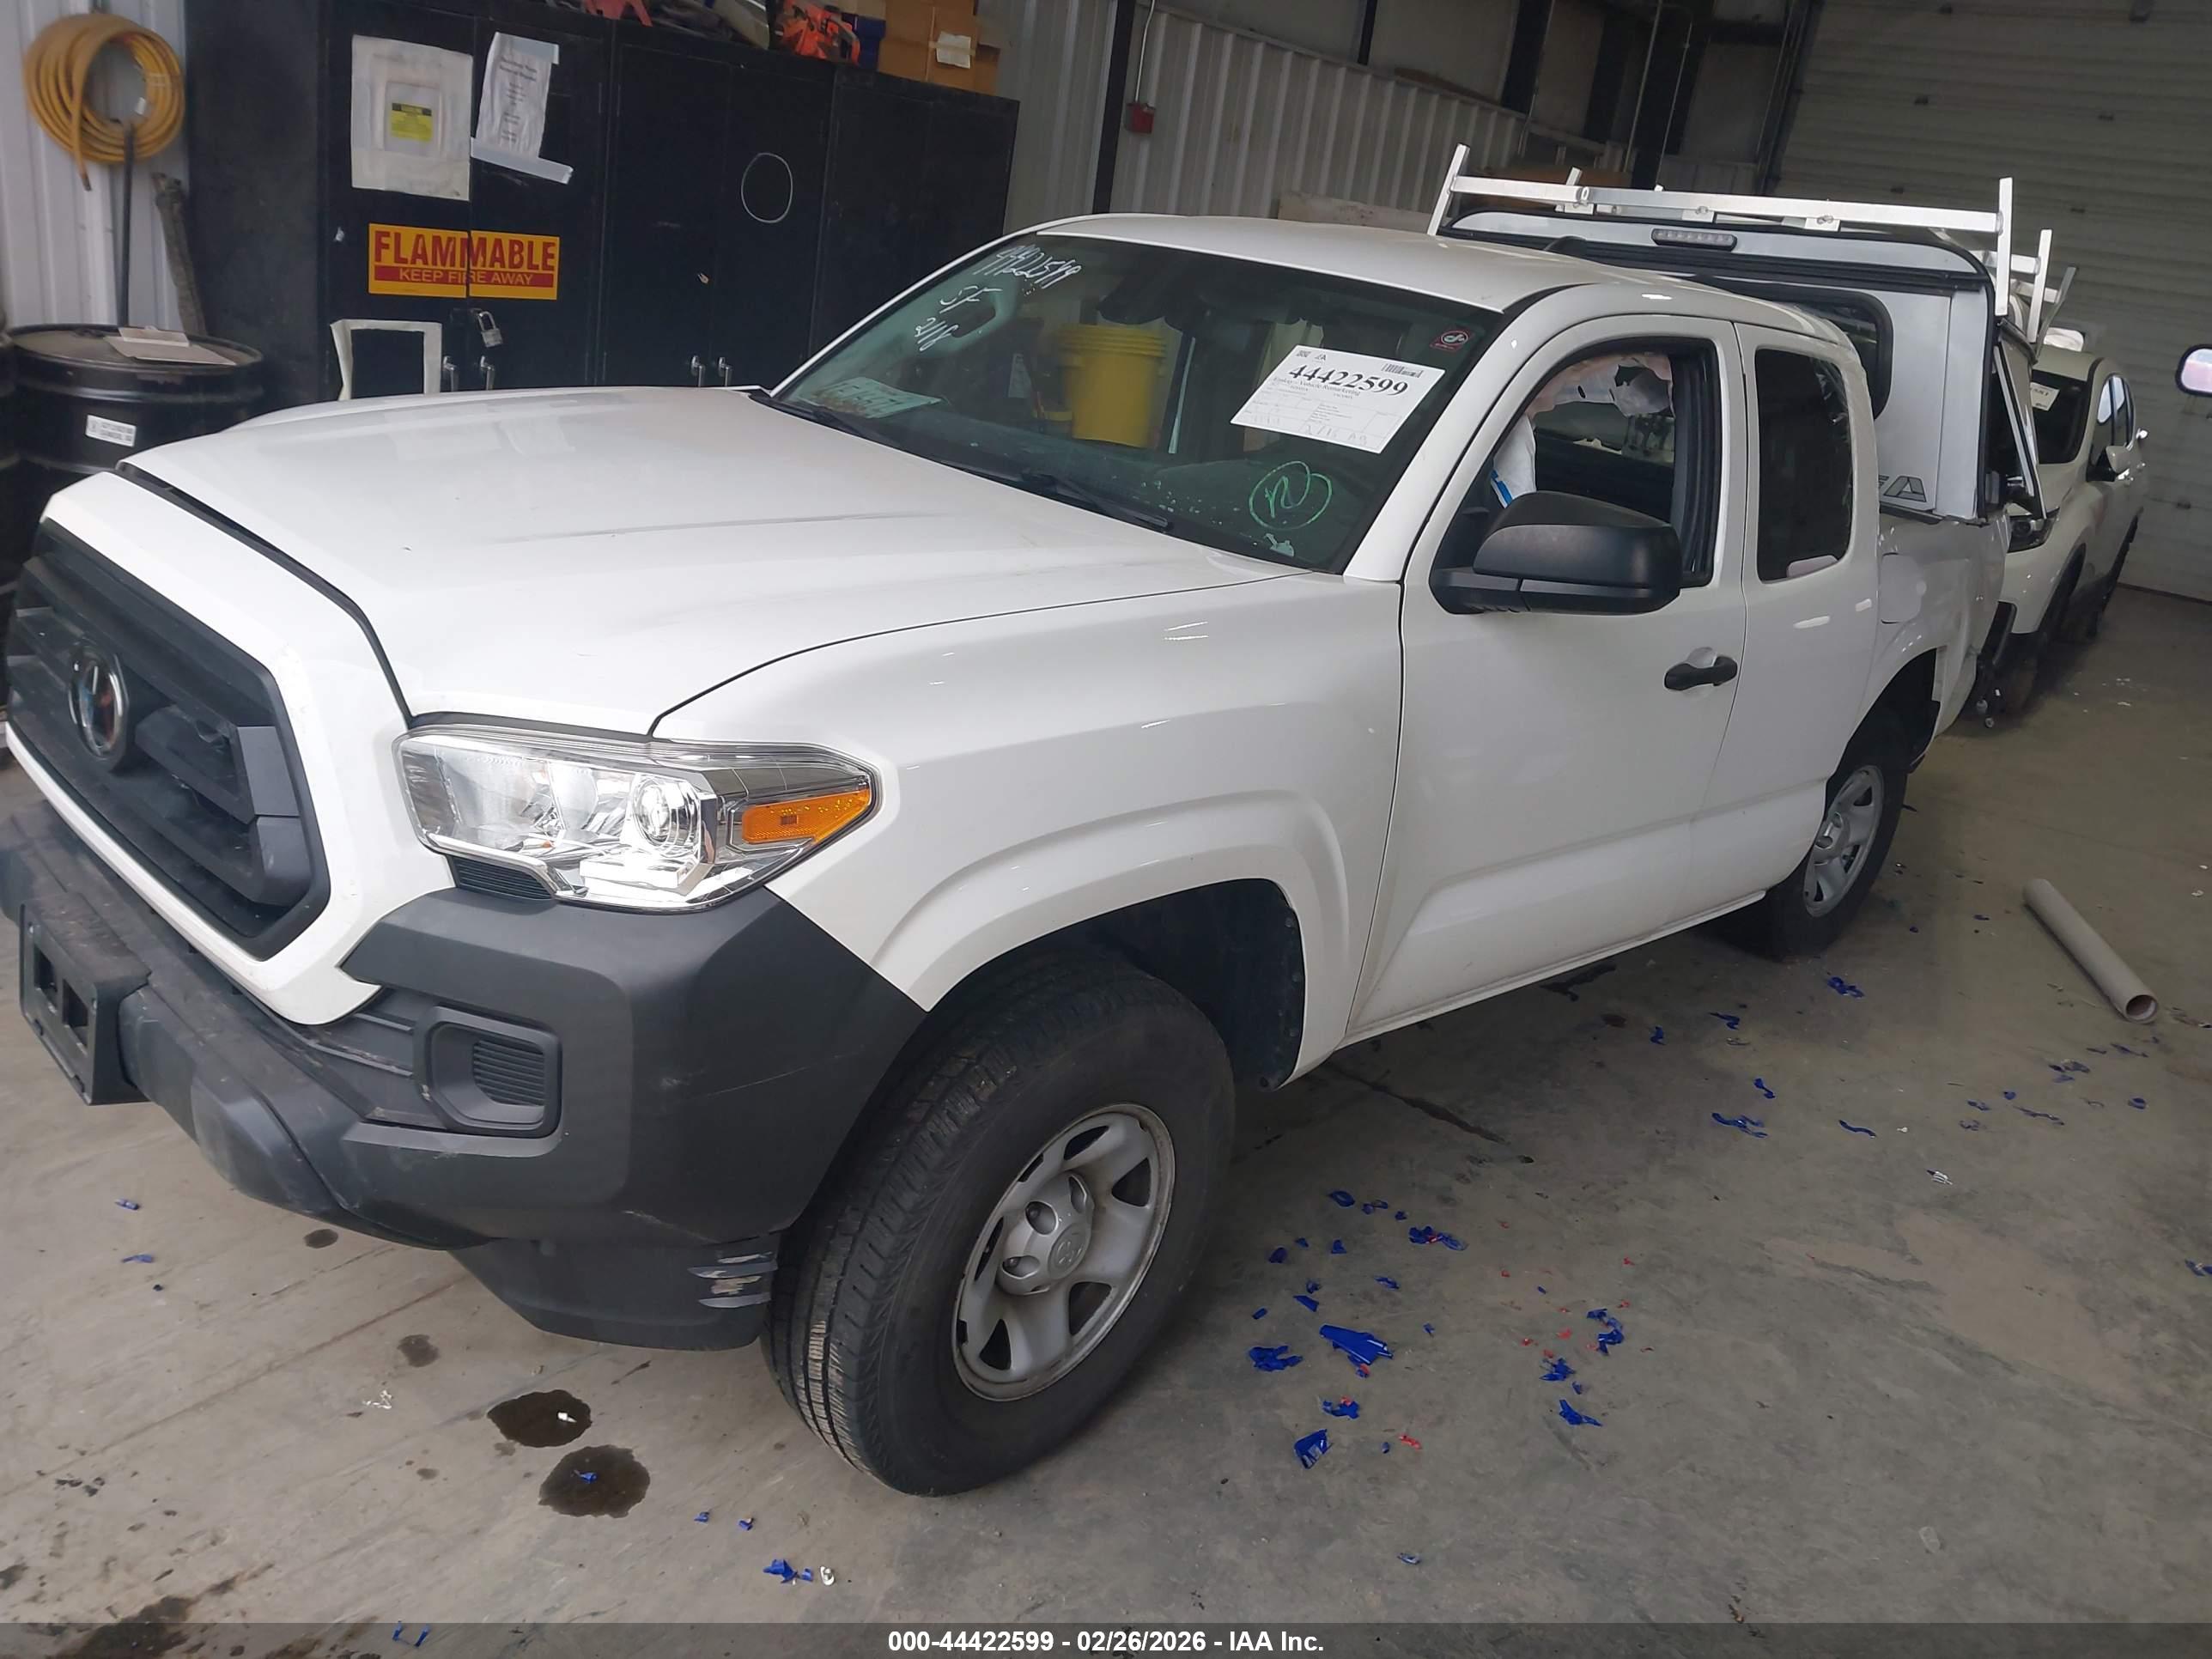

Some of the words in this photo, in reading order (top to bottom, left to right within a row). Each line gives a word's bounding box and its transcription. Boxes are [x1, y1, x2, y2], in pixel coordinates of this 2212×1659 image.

[374, 230, 556, 271] FLAMMABLE
[399, 268, 444, 283] KEEP
[447, 270, 486, 284] FIRE
[490, 272, 533, 286] AWAY
[1288, 364, 1409, 396] 44422599
